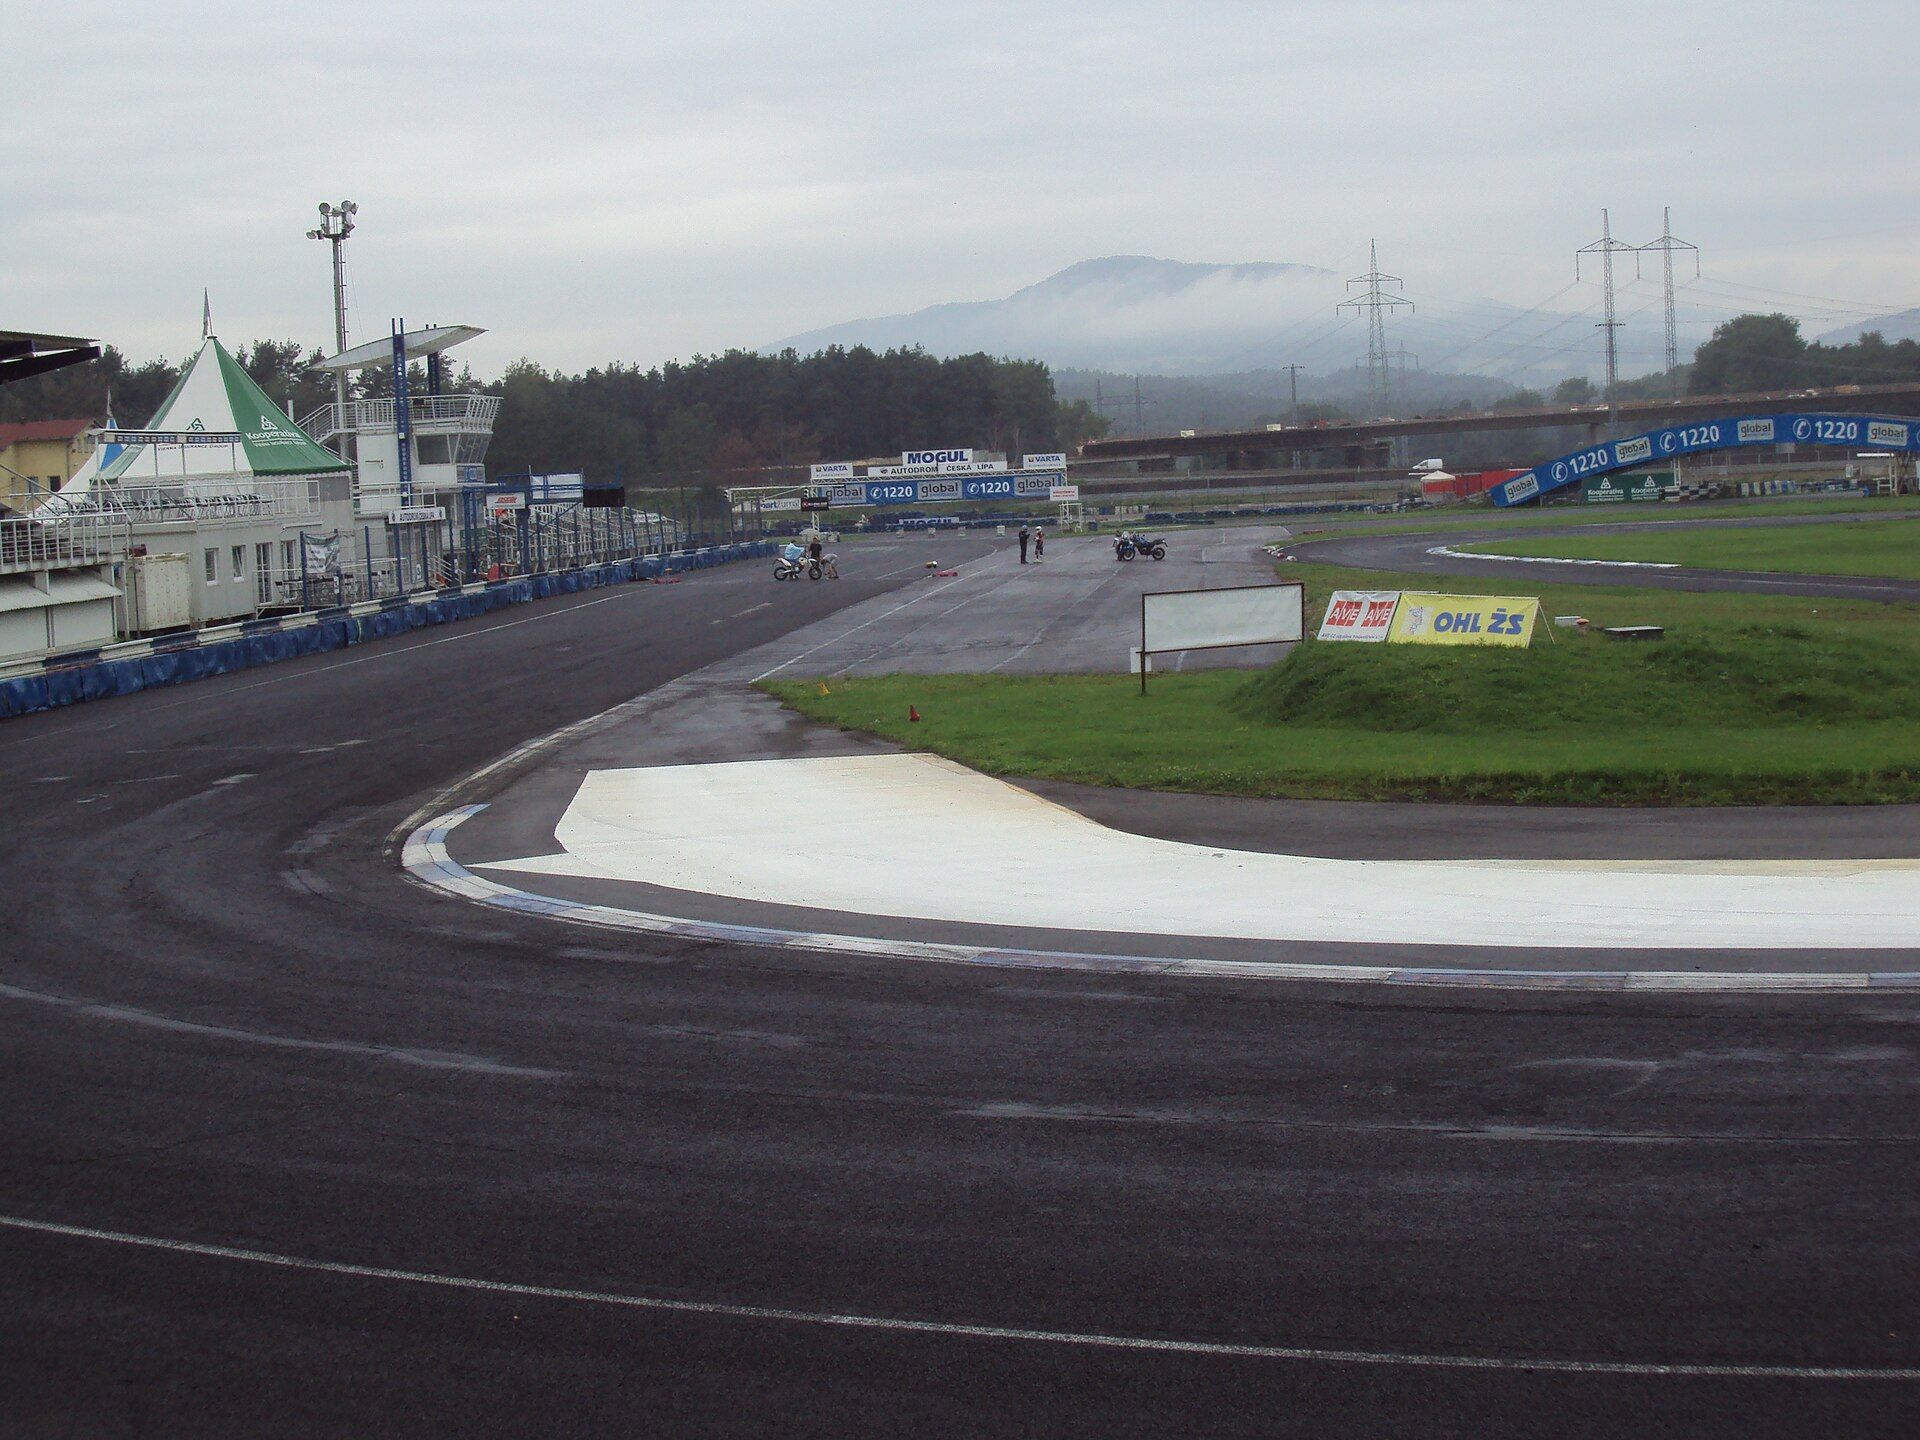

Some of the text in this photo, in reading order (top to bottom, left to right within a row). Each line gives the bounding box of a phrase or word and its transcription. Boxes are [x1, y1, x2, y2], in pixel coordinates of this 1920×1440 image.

[245, 429, 301, 440] Kooperativa
[1679, 425, 1720, 447] 1220
[1740, 422, 1771, 437] global
[1815, 421, 1857, 440] 1220
[1871, 426, 1904, 440] global
[1618, 440, 1648, 459] global
[907, 450, 969, 464] MOGUL
[1034, 455, 1061, 463] VARTA
[1569, 449, 1608, 474] 1220
[822, 464, 848, 472] VARTA
[890, 466, 938, 475] AUTODROM
[883, 486, 913, 498] 1220
[921, 482, 959, 498] global
[979, 481, 1010, 494] 1220
[1017, 477, 1055, 493] global
[1507, 477, 1535, 499] global
[1587, 487, 1624, 496] Kooperativa
[825, 486, 863, 501] global
[1329, 607, 1360, 621] AVE
[1364, 607, 1391, 621] AVE
[1433, 607, 1525, 635] OHL ŽS
